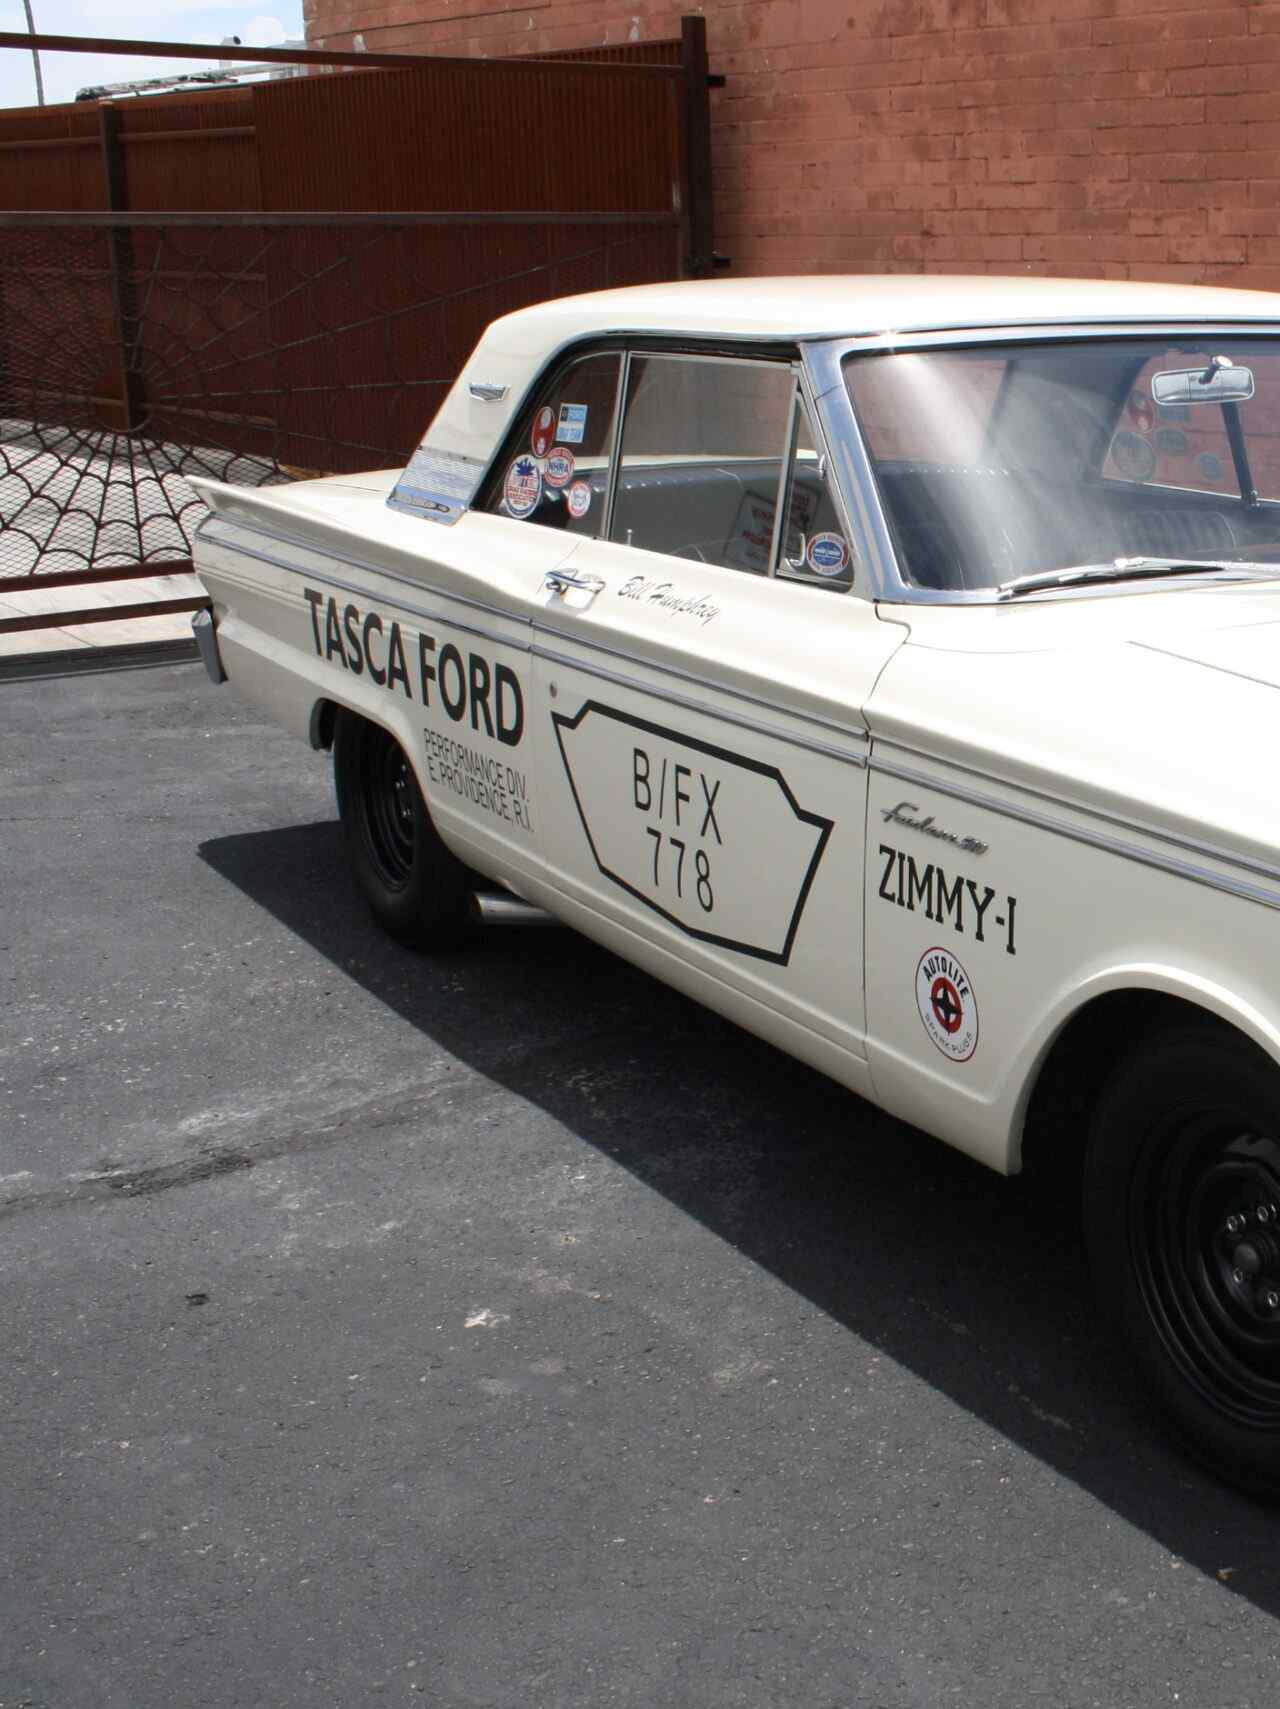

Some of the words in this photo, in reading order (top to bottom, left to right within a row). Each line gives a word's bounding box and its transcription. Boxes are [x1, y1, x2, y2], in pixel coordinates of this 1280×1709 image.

[303, 588, 413, 699] TASCA
[419, 632, 525, 747] FORD
[423, 727, 505, 792] PERFORMANCE
[632, 747, 722, 846] B/FX
[646, 826, 714, 913] 778
[923, 955, 970, 999] AUTOLITE
